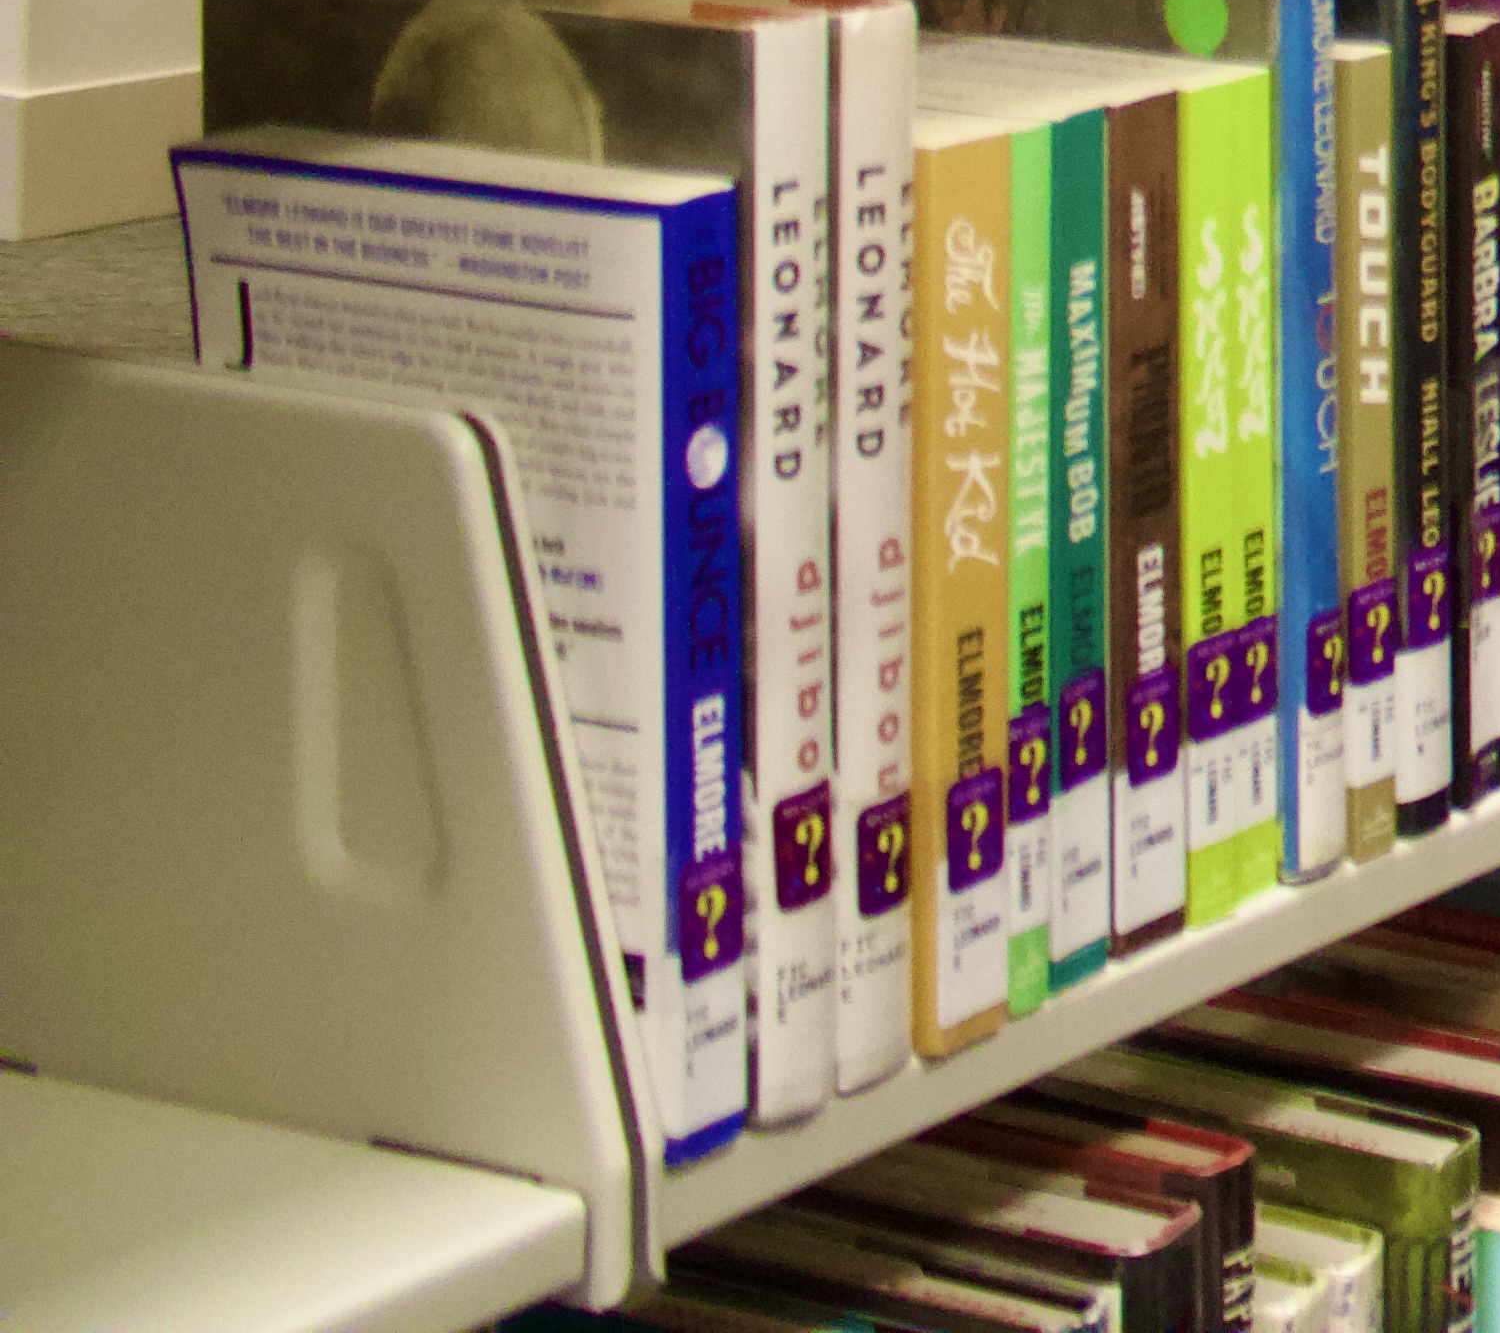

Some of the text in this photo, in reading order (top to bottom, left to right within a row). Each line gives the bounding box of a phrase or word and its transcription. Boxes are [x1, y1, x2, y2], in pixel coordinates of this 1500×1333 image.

[772, 178, 803, 481] LEONARD
[856, 163, 887, 460] LEONARD
[943, 217, 1001, 315] The
[1062, 259, 1100, 458] MAXIMUM
[1358, 144, 1390, 406] TOUCH
[1419, 20, 1440, 548] KING'S BODYGUARD NIALL LEO
[1472, 172, 1500, 361] BARBRA
[941, 331, 1002, 438] Hot
[1013, 346, 1048, 555] MAJESTYK
[944, 452, 1002, 574] Kid
[1067, 458, 1100, 545] BOB
